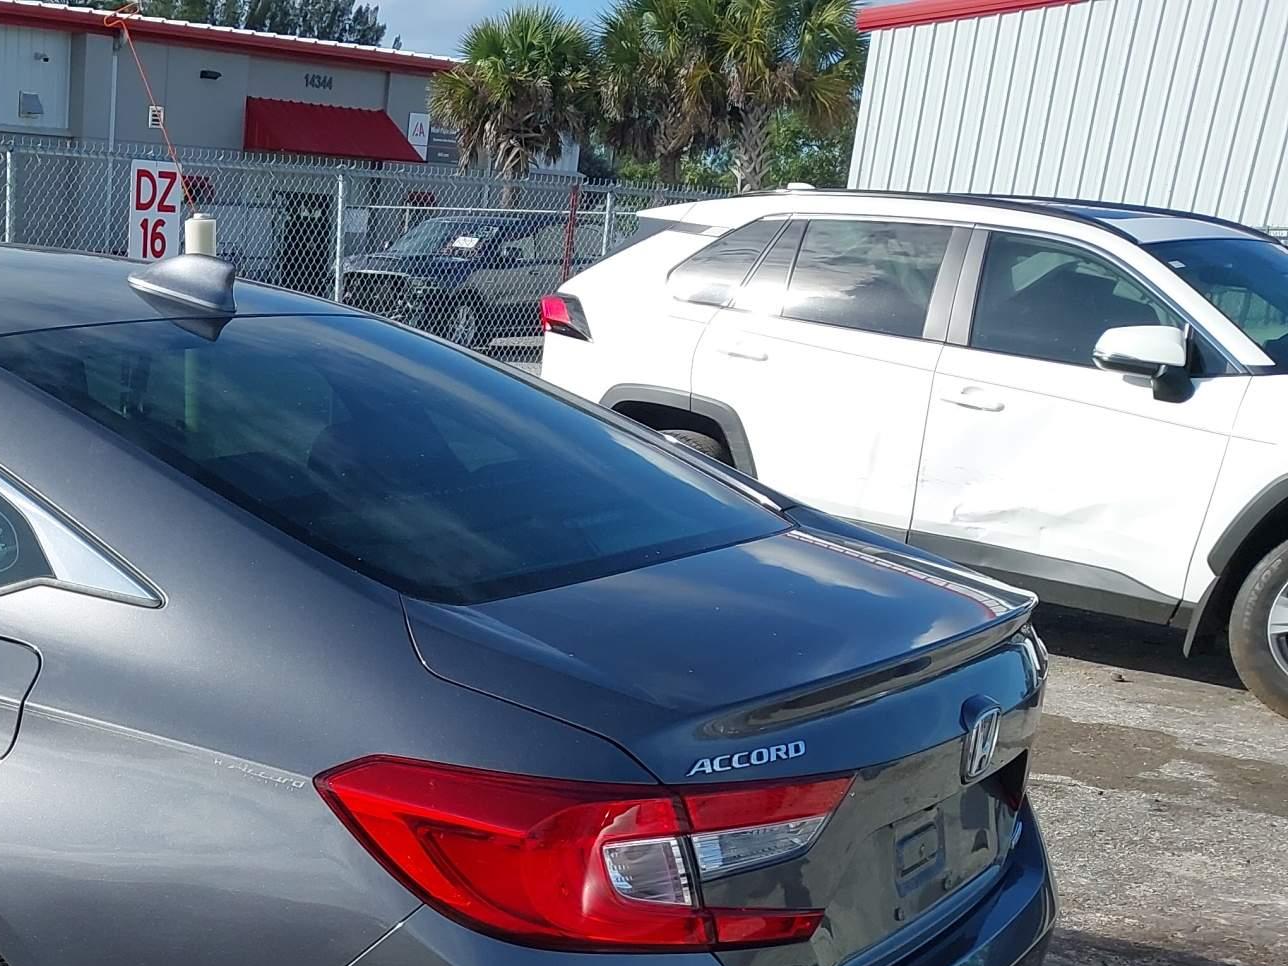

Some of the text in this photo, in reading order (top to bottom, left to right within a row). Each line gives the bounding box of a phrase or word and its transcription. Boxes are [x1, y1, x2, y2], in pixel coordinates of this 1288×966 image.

[304, 73, 333, 90] 14344
[135, 169, 178, 213] DZ
[140, 218, 167, 259] 16
[686, 740, 807, 777] ACCORD
